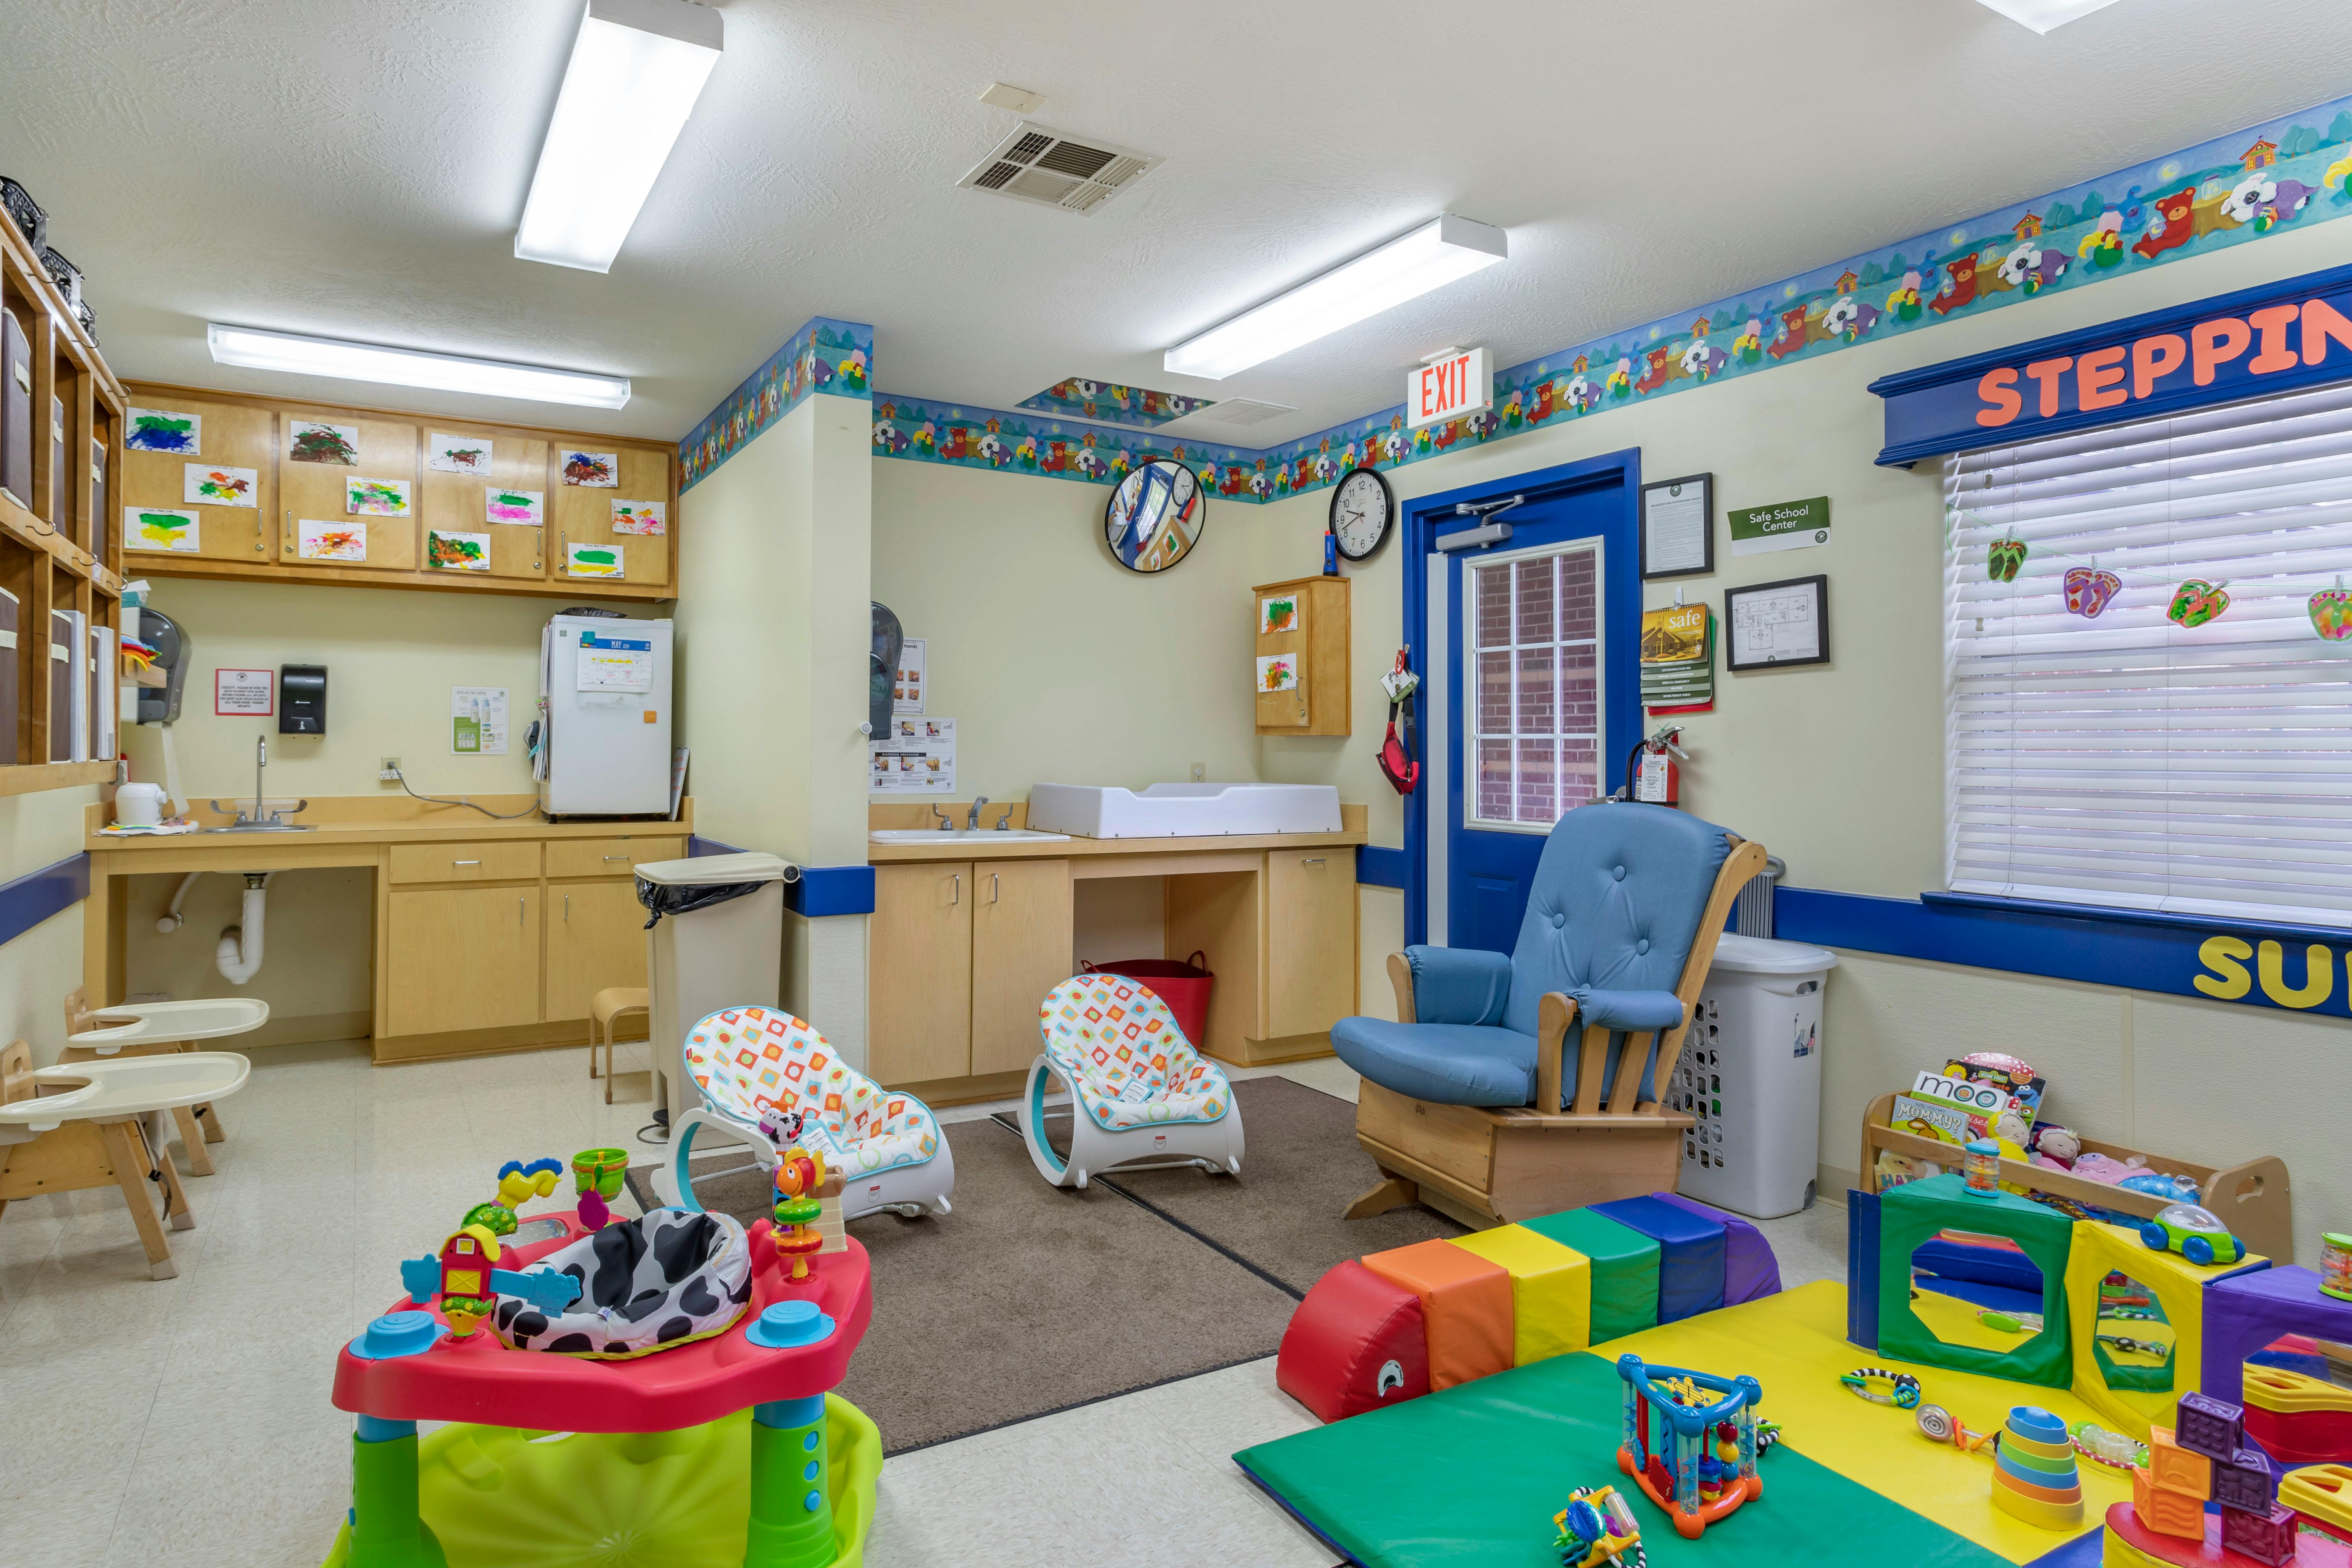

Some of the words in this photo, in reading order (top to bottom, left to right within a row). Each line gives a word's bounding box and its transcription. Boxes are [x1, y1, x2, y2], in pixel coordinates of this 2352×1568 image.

[1975, 299, 2352, 427] STEPPIN
[1422, 355, 1470, 417] EXIT
[1358, 481, 1365, 490] 12
[1369, 483, 1372, 492] 1
[1349, 488, 1354, 498] 11
[1377, 490, 1381, 500] 2
[1343, 499, 1349, 508] 10
[1380, 505, 1384, 514] 3
[1750, 511, 1771, 523] Safe
[1774, 505, 1808, 520] School
[1341, 515, 1345, 524] 9
[1377, 521, 1382, 530] 4
[1763, 520, 1797, 531] Center
[1344, 528, 1348, 537] 8
[1370, 533, 1375, 542] 5
[1351, 538, 1355, 547] 7
[1361, 539, 1365, 548] 6
[1669, 609, 1700, 629] safe
[2193, 936, 2352, 1014] SU
[1920, 1076, 1997, 1107] moo
[1897, 1102, 1962, 1134] MOMMY?
[1969, 1115, 1988, 1127] ises
